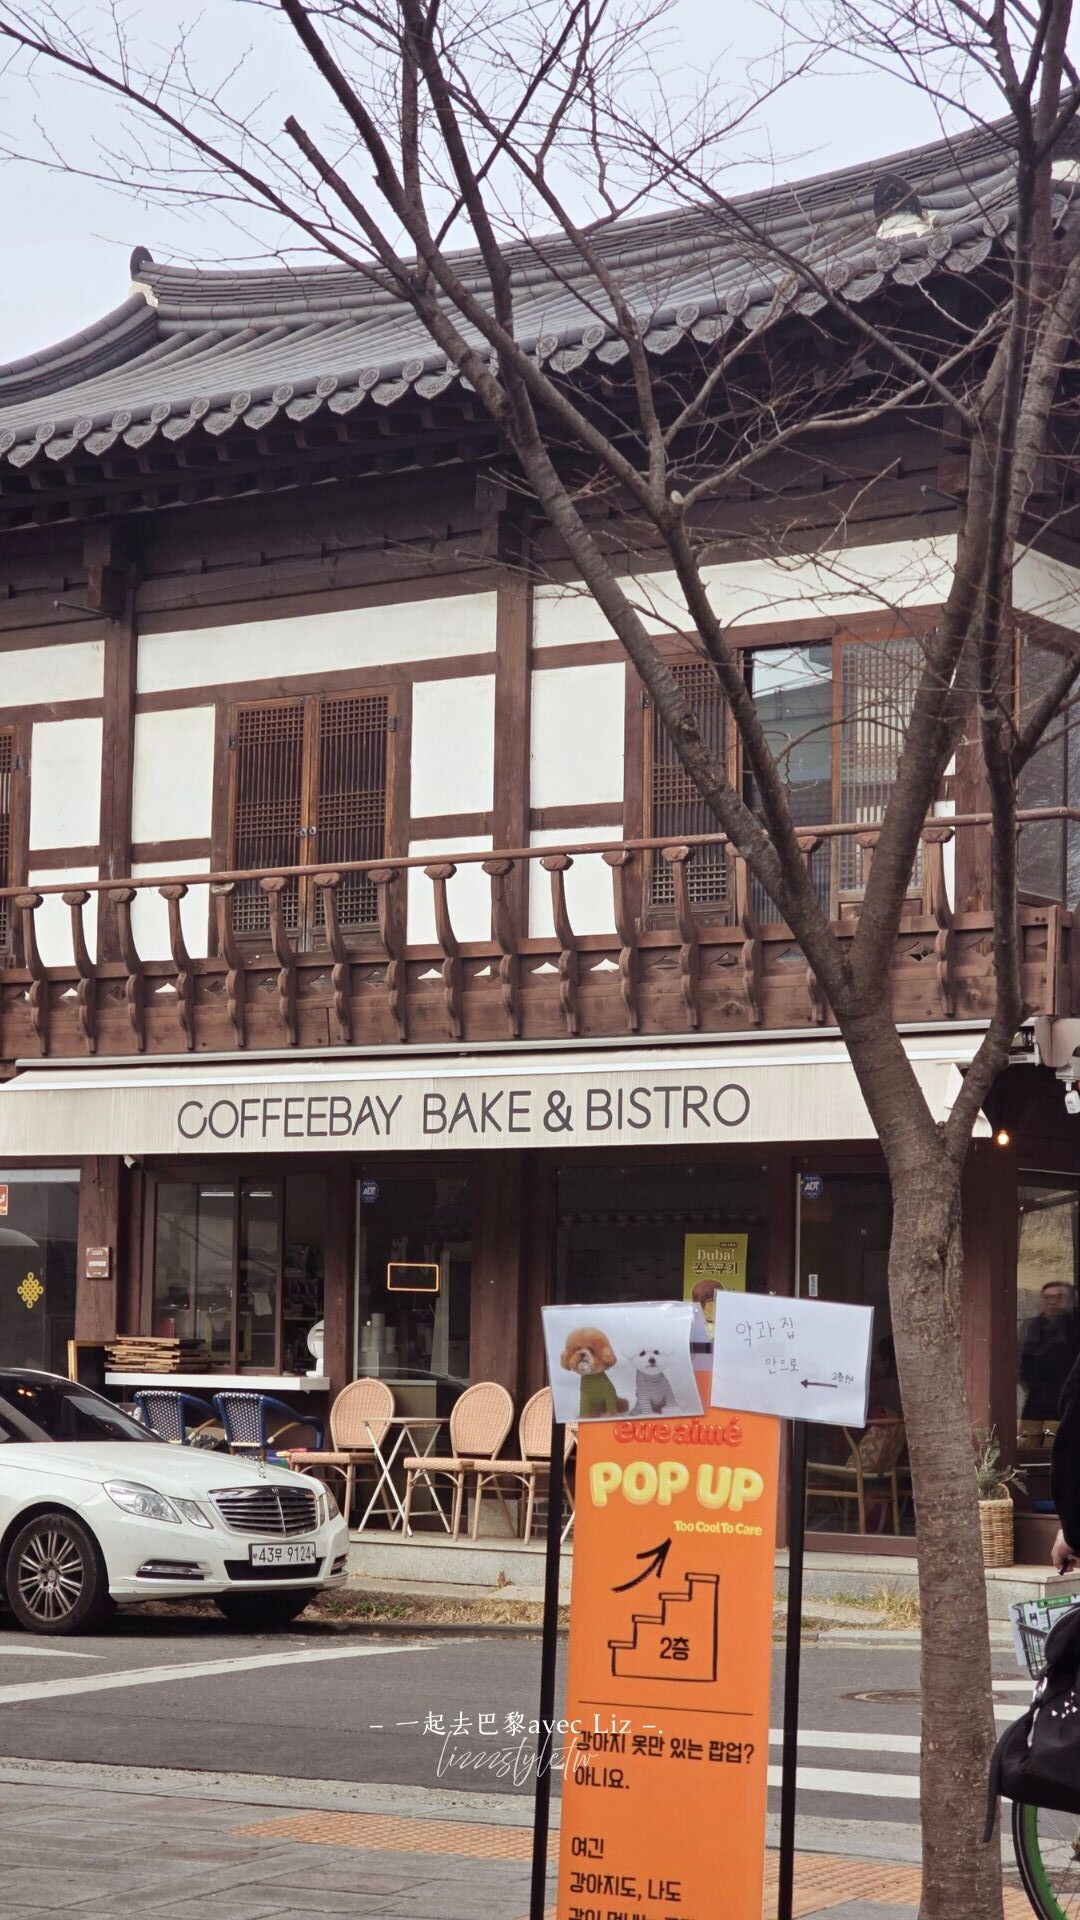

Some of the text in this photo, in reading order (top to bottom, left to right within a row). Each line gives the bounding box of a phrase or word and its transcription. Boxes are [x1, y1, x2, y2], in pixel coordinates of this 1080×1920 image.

[177, 1083, 750, 1139] COFFEEBAY BAKE & BISTRO
[803, 1181, 820, 1192] ADT
[696, 1248, 736, 1261] Dubai
[765, 1357, 799, 1375] 안으로
[590, 1461, 764, 1512] POP UP
[674, 1520, 763, 1536] Too Cool To Care
[259, 1546, 311, 1563] 43무 9124
[659, 1637, 690, 1661] 2층
[577, 1731, 755, 1764] 강아지 옷만 있는 팝업?
[575, 1765, 630, 1789] 아니요.
[571, 1836, 605, 1860] 여긴
[569, 1871, 682, 1902] 강아지도, 나도
